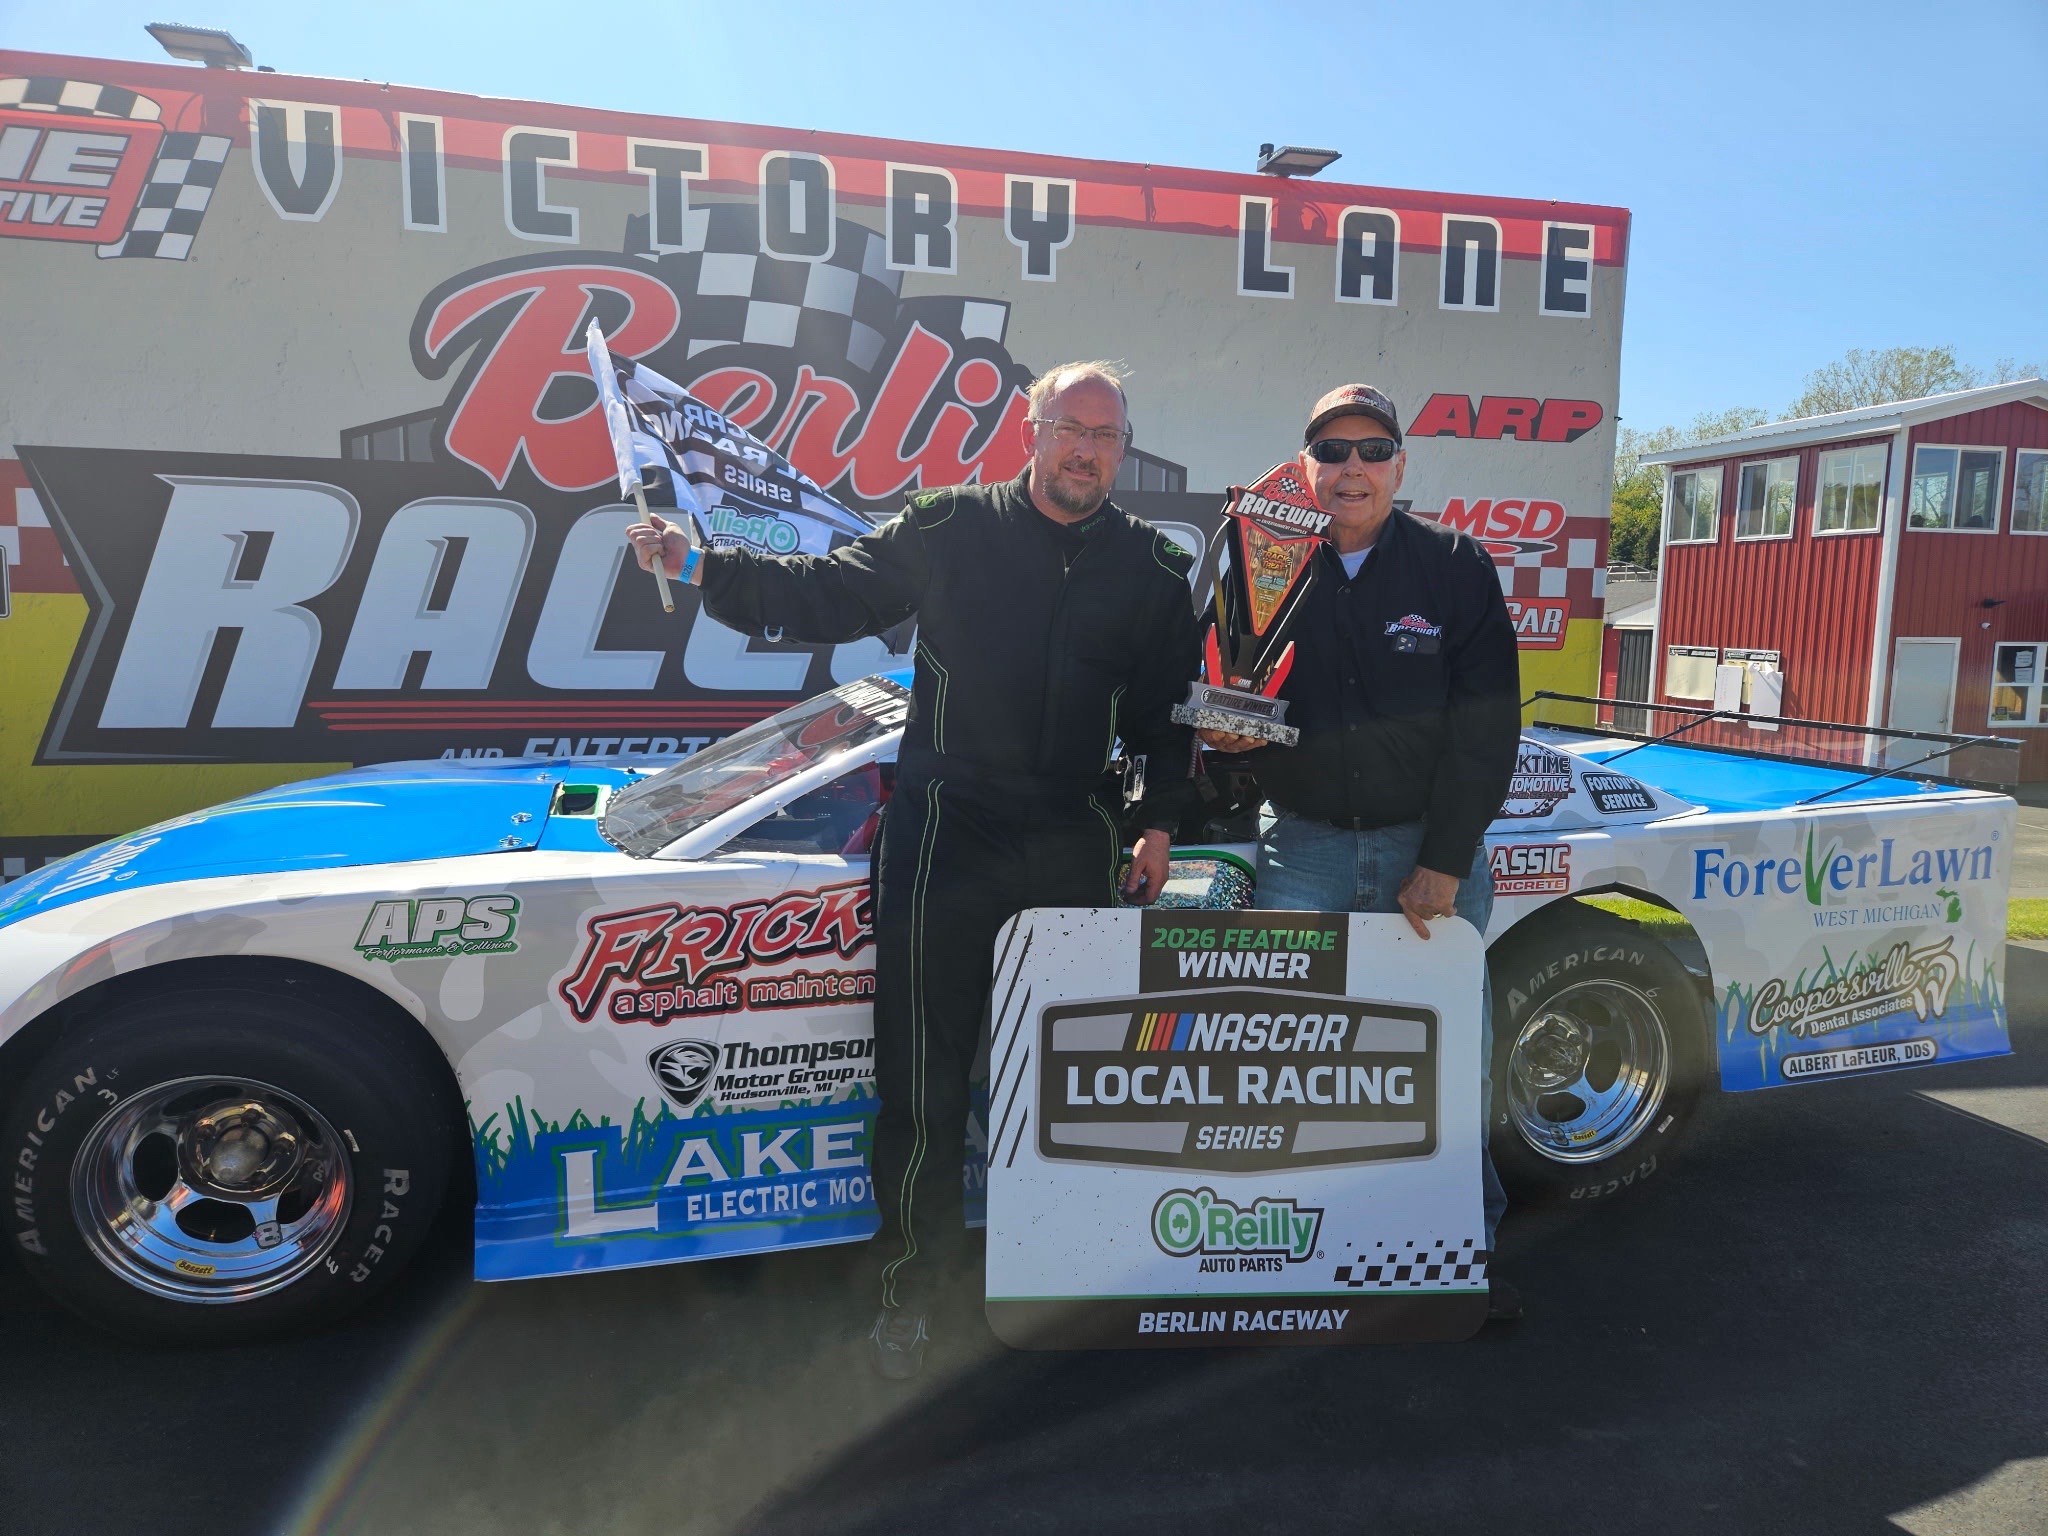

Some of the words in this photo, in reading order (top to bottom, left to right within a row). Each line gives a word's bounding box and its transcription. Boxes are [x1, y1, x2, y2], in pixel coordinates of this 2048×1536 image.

[248, 97, 1077, 282] VICTORY
[1237, 194, 1595, 318] LANE
[424, 264, 1032, 498] Berli
[1405, 393, 1604, 443] ARP
[1236, 491, 1332, 534] RACEWAY
[1439, 498, 1566, 541] MSD
[1515, 754, 1571, 774] KTIME
[1586, 776, 1640, 792] FORTON'S
[1601, 792, 1648, 810] SERVICE
[357, 896, 517, 946] APS
[1813, 909, 1859, 927] WEST
[1863, 903, 1942, 924] MICHIGAN
[365, 946, 443, 960] Performance
[462, 940, 513, 952] Collision
[565, 884, 873, 1013] FRICK
[1151, 928, 1216, 950] 2026
[1223, 928, 1338, 951] FEATURE
[1178, 951, 1311, 979] WINNER
[1506, 946, 1646, 1019] AMERICAN
[614, 983, 738, 1017] asphalt
[1750, 943, 1920, 1034] Coopersville
[1187, 1012, 1350, 1052] NASCAR
[1811, 1010, 1849, 1034] Dental
[1851, 995, 1913, 1024] Associates
[713, 1072, 781, 1091] Motor
[783, 1066, 855, 1088] Group
[1788, 1054, 1838, 1075] ALBERT
[1842, 1048, 1901, 1068] LaFLEUR,
[1904, 1042, 1931, 1058] DDS
[719, 1087, 812, 1103] Hudsonville,
[813, 1082, 832, 1094] MI
[1066, 1065, 1224, 1105] LOCAL
[1237, 1064, 1415, 1105] RACING
[1195, 1125, 1285, 1150] SERIES
[14, 1066, 99, 1257] AMERICAN
[560, 1119, 865, 1238] LAKE
[1570, 1155, 1657, 1200] RACER
[688, 1181, 818, 1222] ELECTRIC
[349, 1168, 411, 1283] RACER
[1158, 1194, 1314, 1254] O'Reilly
[1199, 1258, 1236, 1273] AUTO
[1238, 1258, 1283, 1273] PARTS
[1138, 1311, 1228, 1334] BERLIN
[1231, 1309, 1350, 1332] RACEWAY
